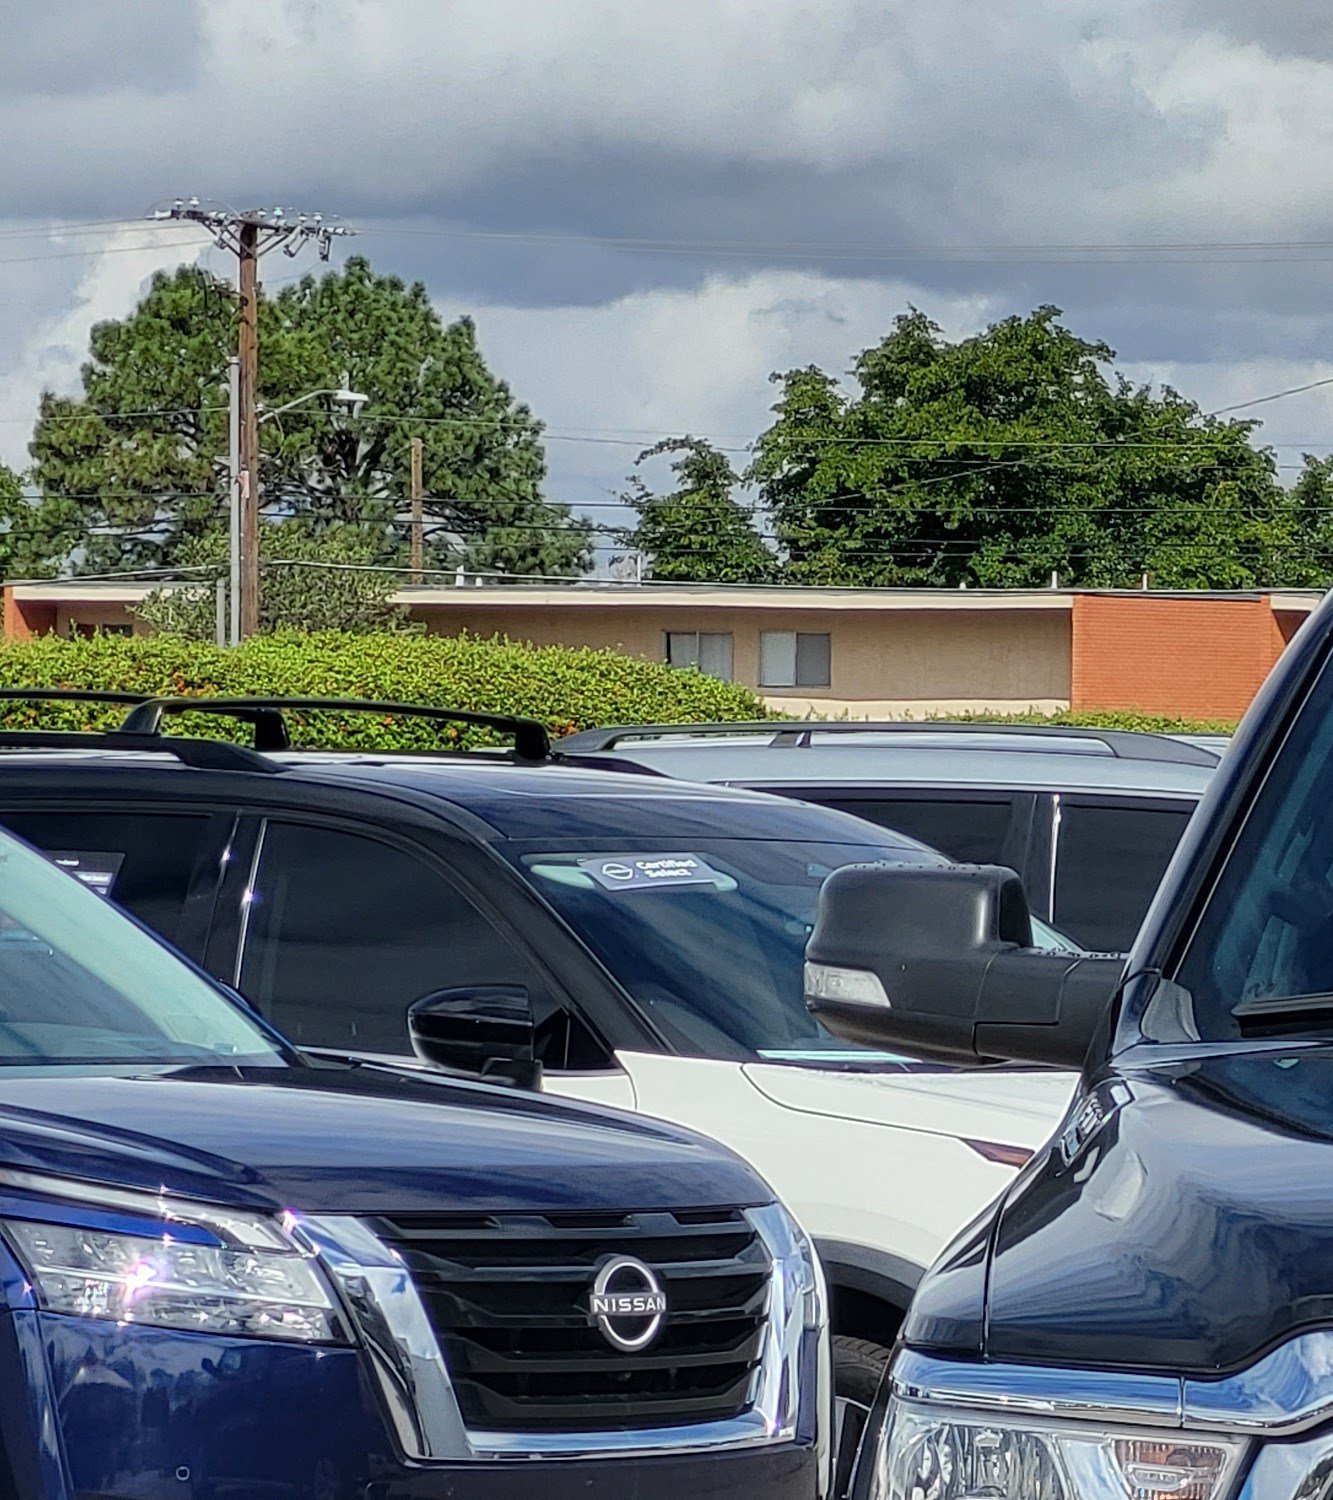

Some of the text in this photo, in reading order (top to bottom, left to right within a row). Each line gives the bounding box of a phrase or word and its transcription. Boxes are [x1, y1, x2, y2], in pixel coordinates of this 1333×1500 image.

[635, 859, 698, 870] Certified
[644, 869, 691, 878] Select
[593, 1297, 665, 1312] NISSAN
